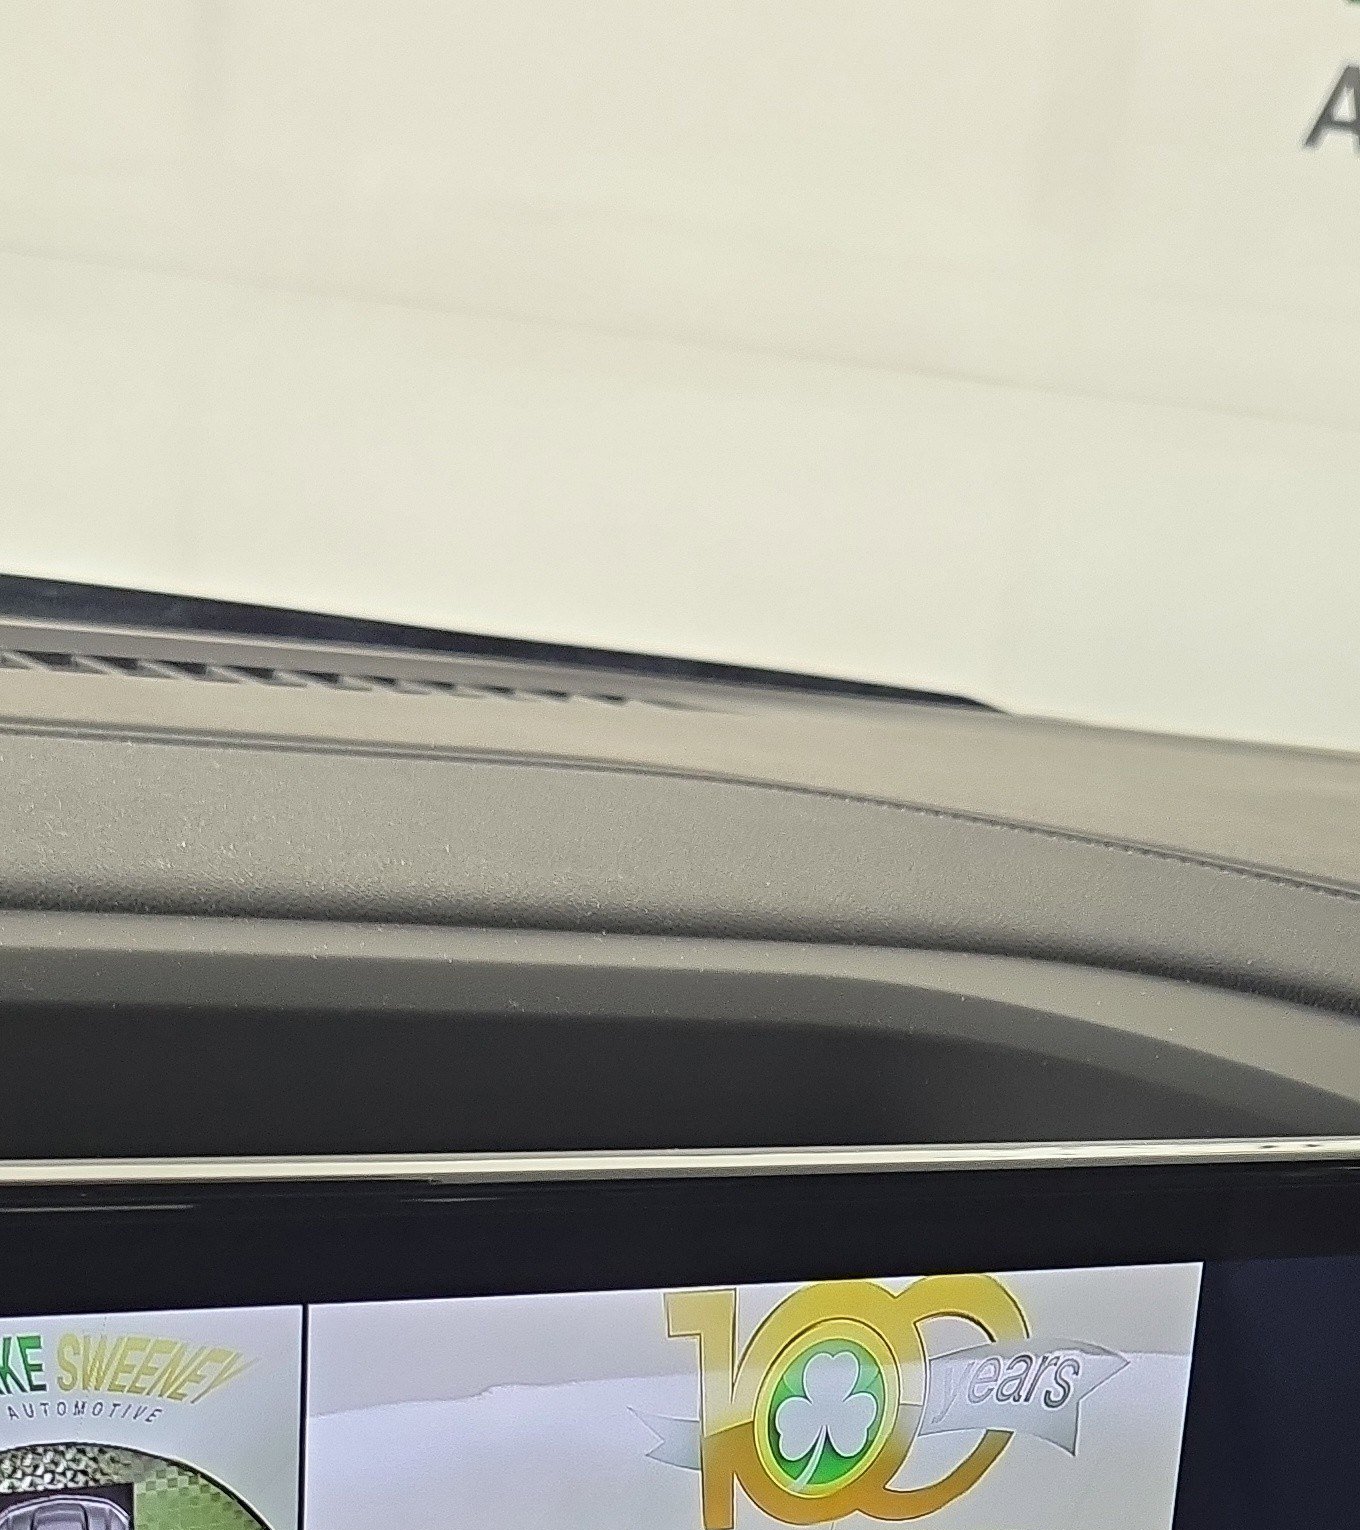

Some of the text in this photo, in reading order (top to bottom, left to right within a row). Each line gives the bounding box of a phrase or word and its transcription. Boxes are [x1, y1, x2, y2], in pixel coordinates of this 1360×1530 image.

[55, 1331, 261, 1405] SWEENEY
[930, 1349, 1082, 1424] years
[7, 1399, 163, 1424] AUTOMOTIVE
